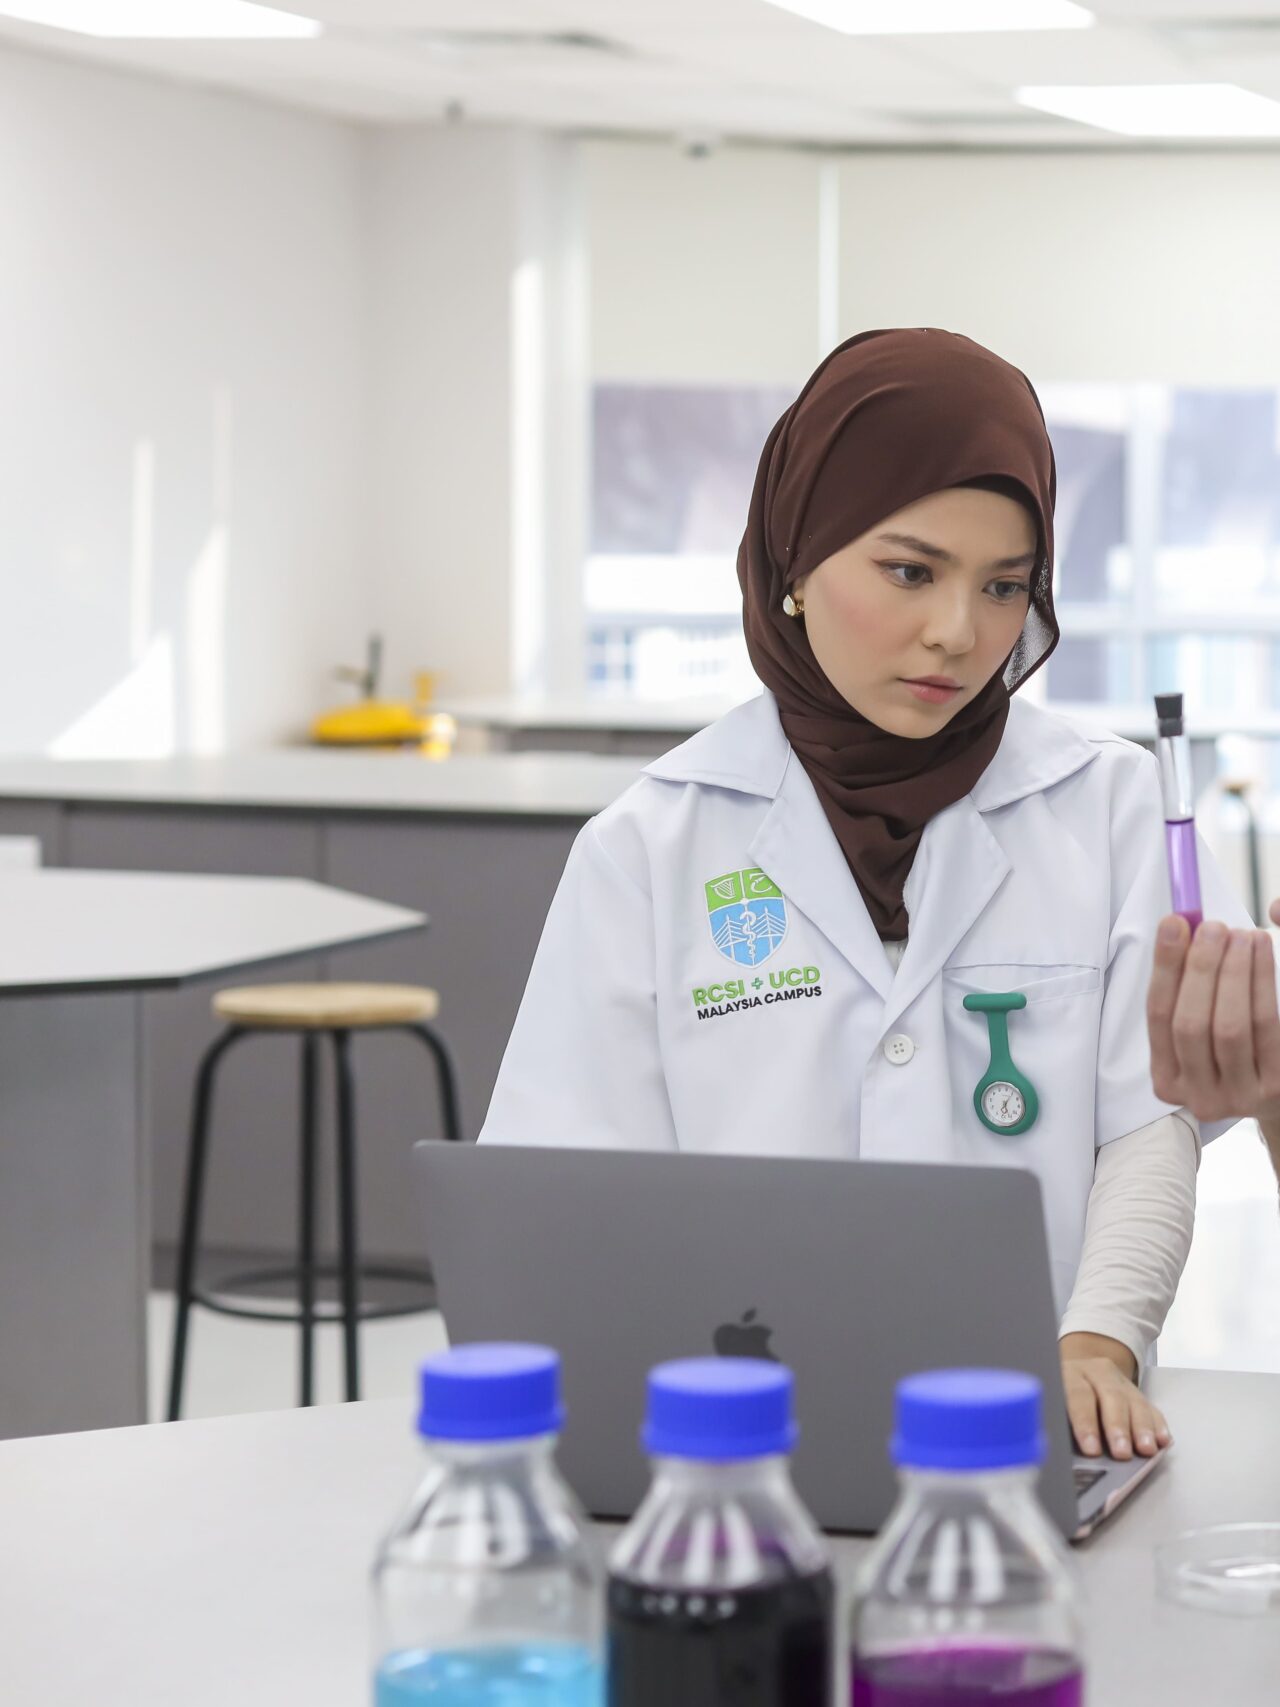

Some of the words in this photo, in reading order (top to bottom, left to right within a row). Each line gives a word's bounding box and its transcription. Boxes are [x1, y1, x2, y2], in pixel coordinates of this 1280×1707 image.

[692, 980, 745, 1006] RCSI
[752, 977, 764, 990] +
[769, 966, 821, 989] UCD
[697, 997, 763, 1020] MALAYSIA
[764, 986, 822, 1004] CAMPUS
